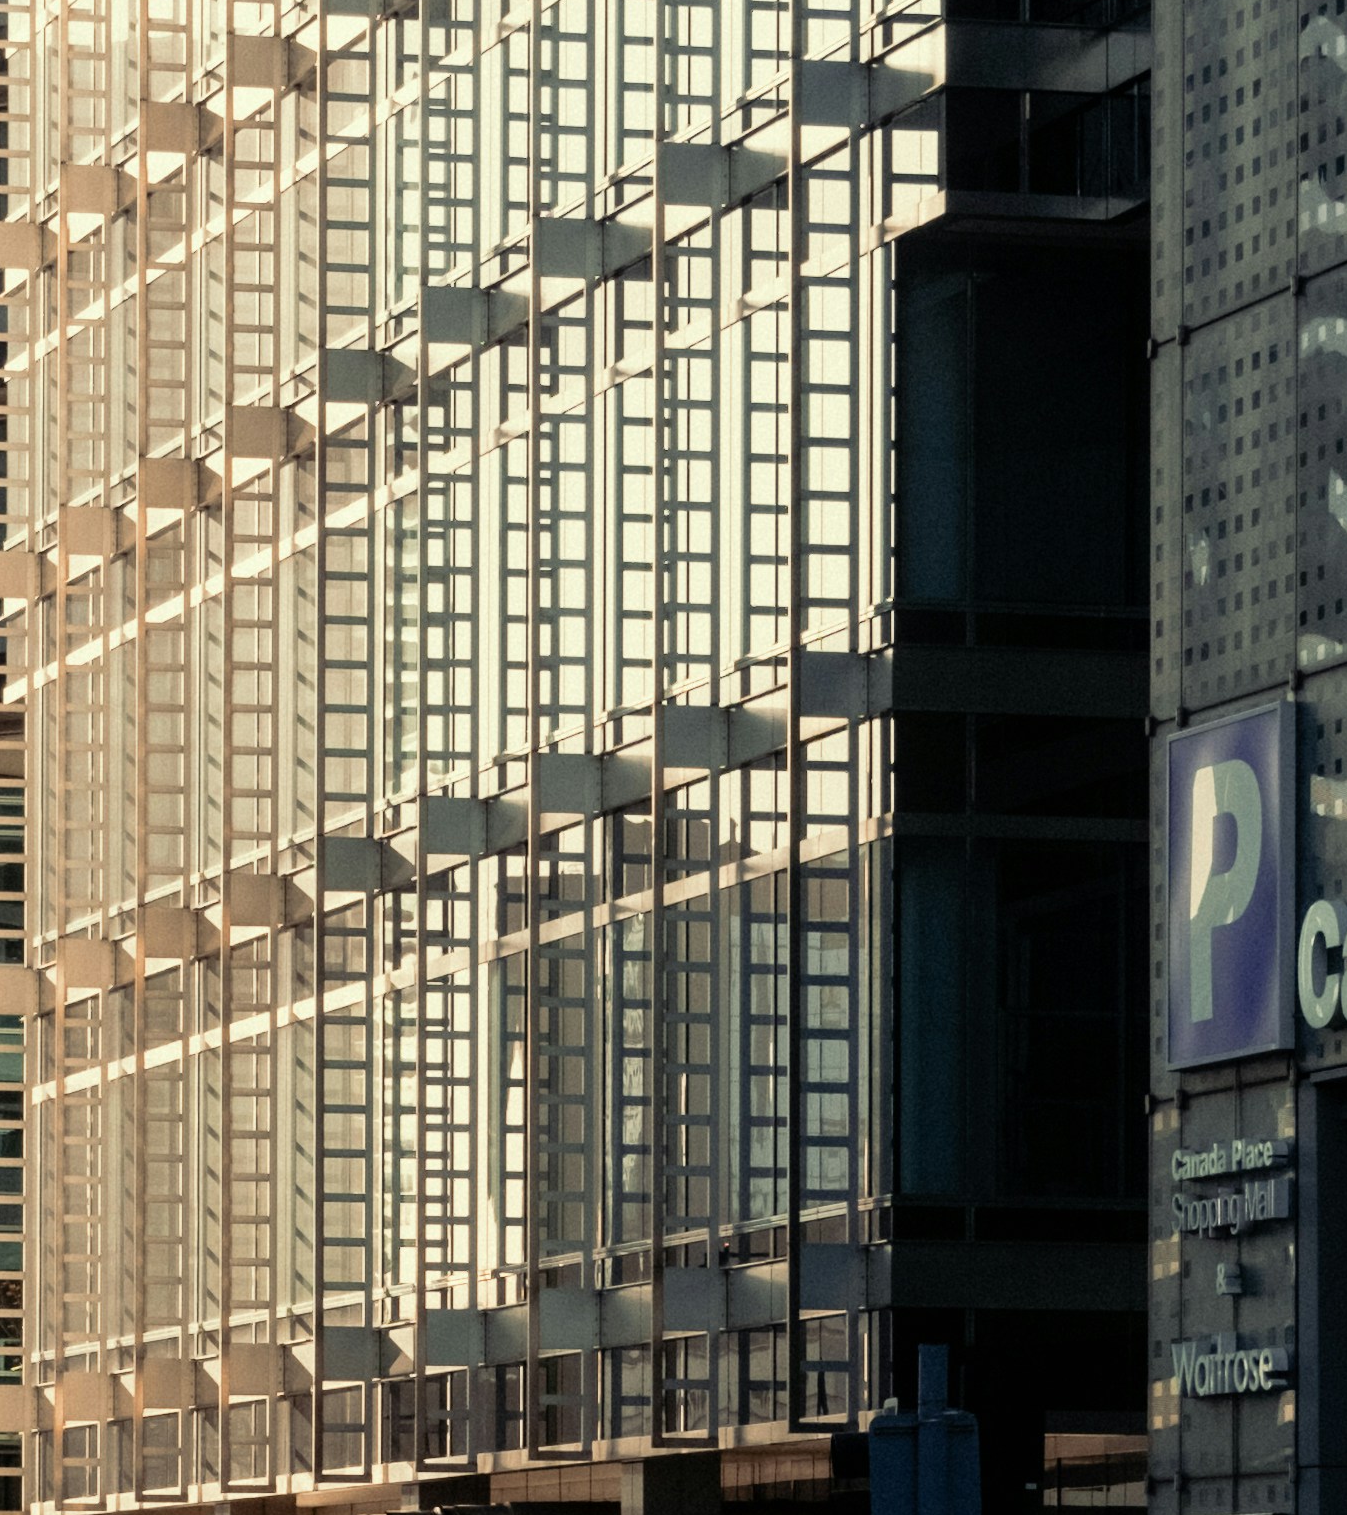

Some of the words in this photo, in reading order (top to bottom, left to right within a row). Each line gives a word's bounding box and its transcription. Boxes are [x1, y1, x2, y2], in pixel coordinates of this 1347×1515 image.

[1190, 758, 1263, 1024] P
[1171, 1143, 1228, 1182] Canada
[1231, 1139, 1274, 1171] Place
[1171, 1188, 1240, 1239] Shopping
[1243, 1177, 1275, 1223] Mall
[1171, 1333, 1274, 1398] Waitrose
